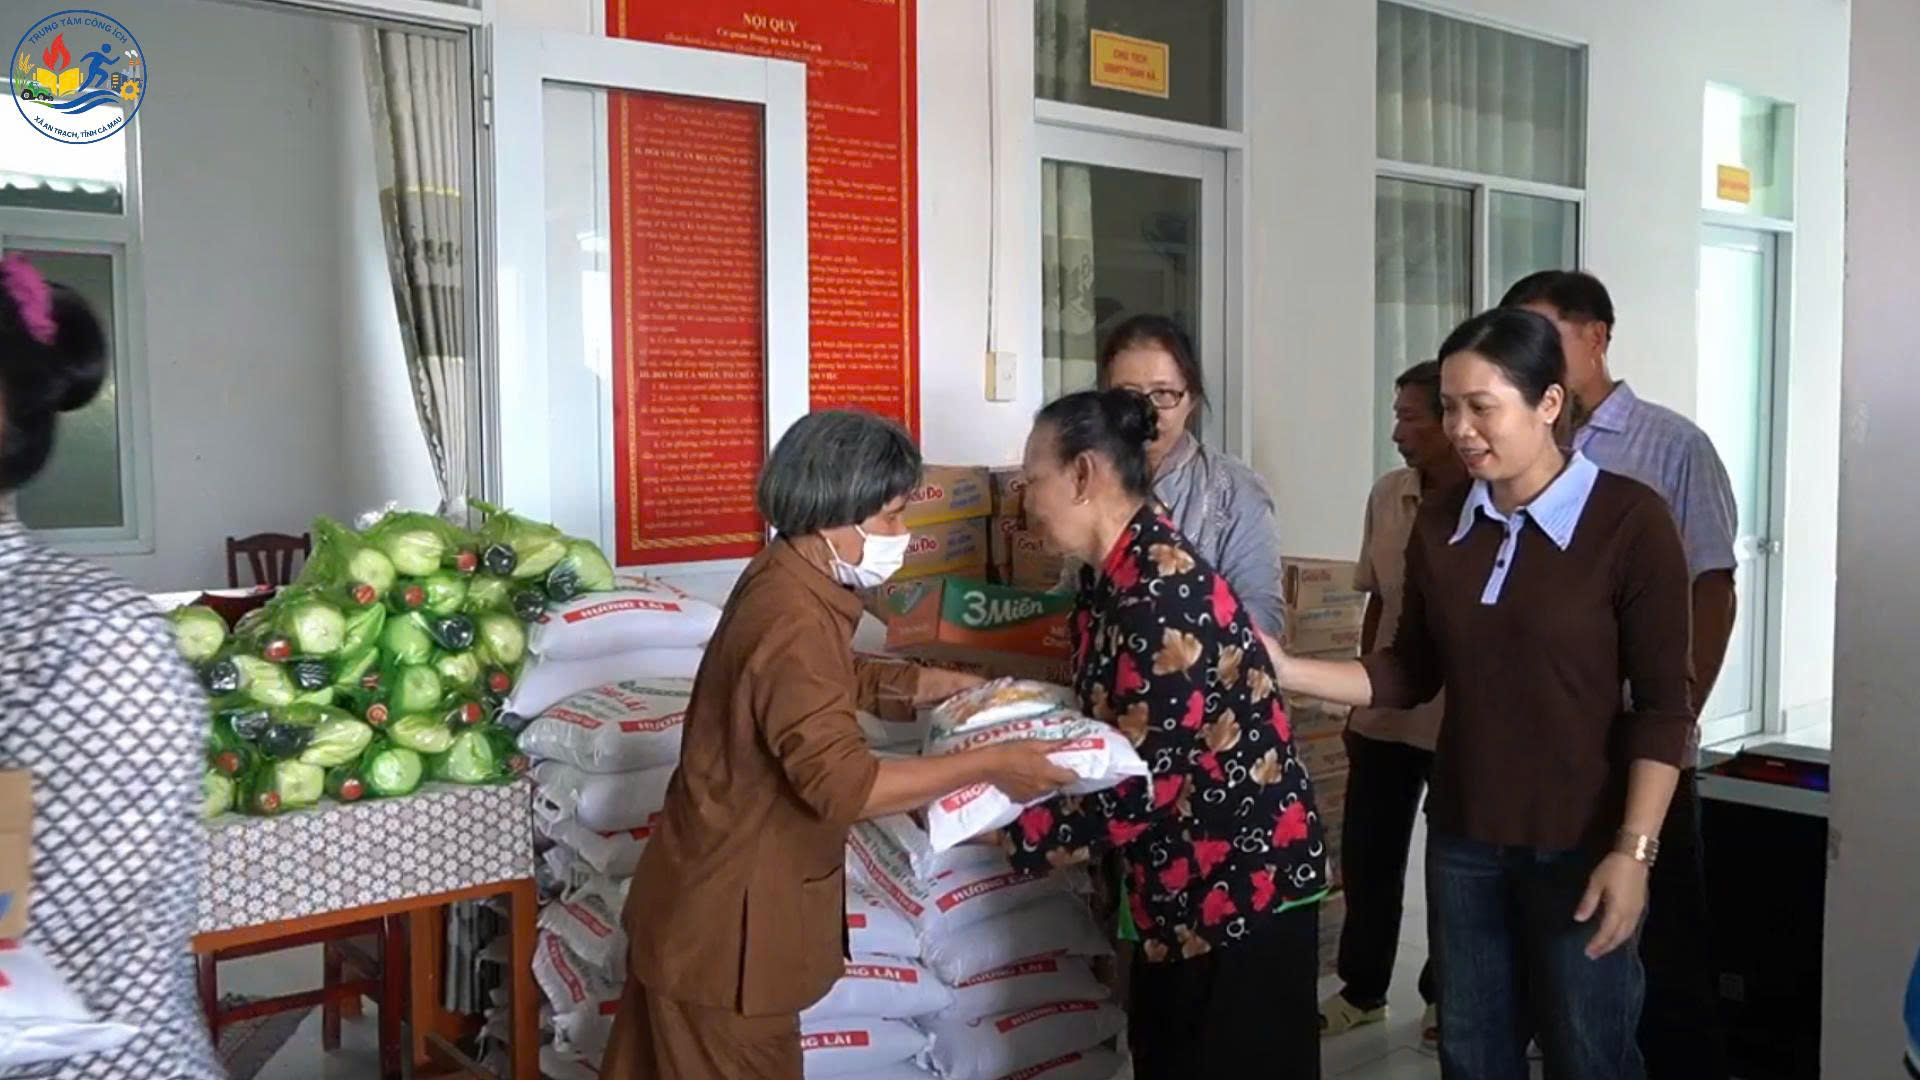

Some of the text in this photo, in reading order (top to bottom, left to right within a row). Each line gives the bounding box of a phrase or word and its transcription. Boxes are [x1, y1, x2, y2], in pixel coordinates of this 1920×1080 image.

[743, 12, 798, 33] NỘI QUY
[962, 590, 987, 627] 3
[822, 1032, 852, 1045] LÀI
